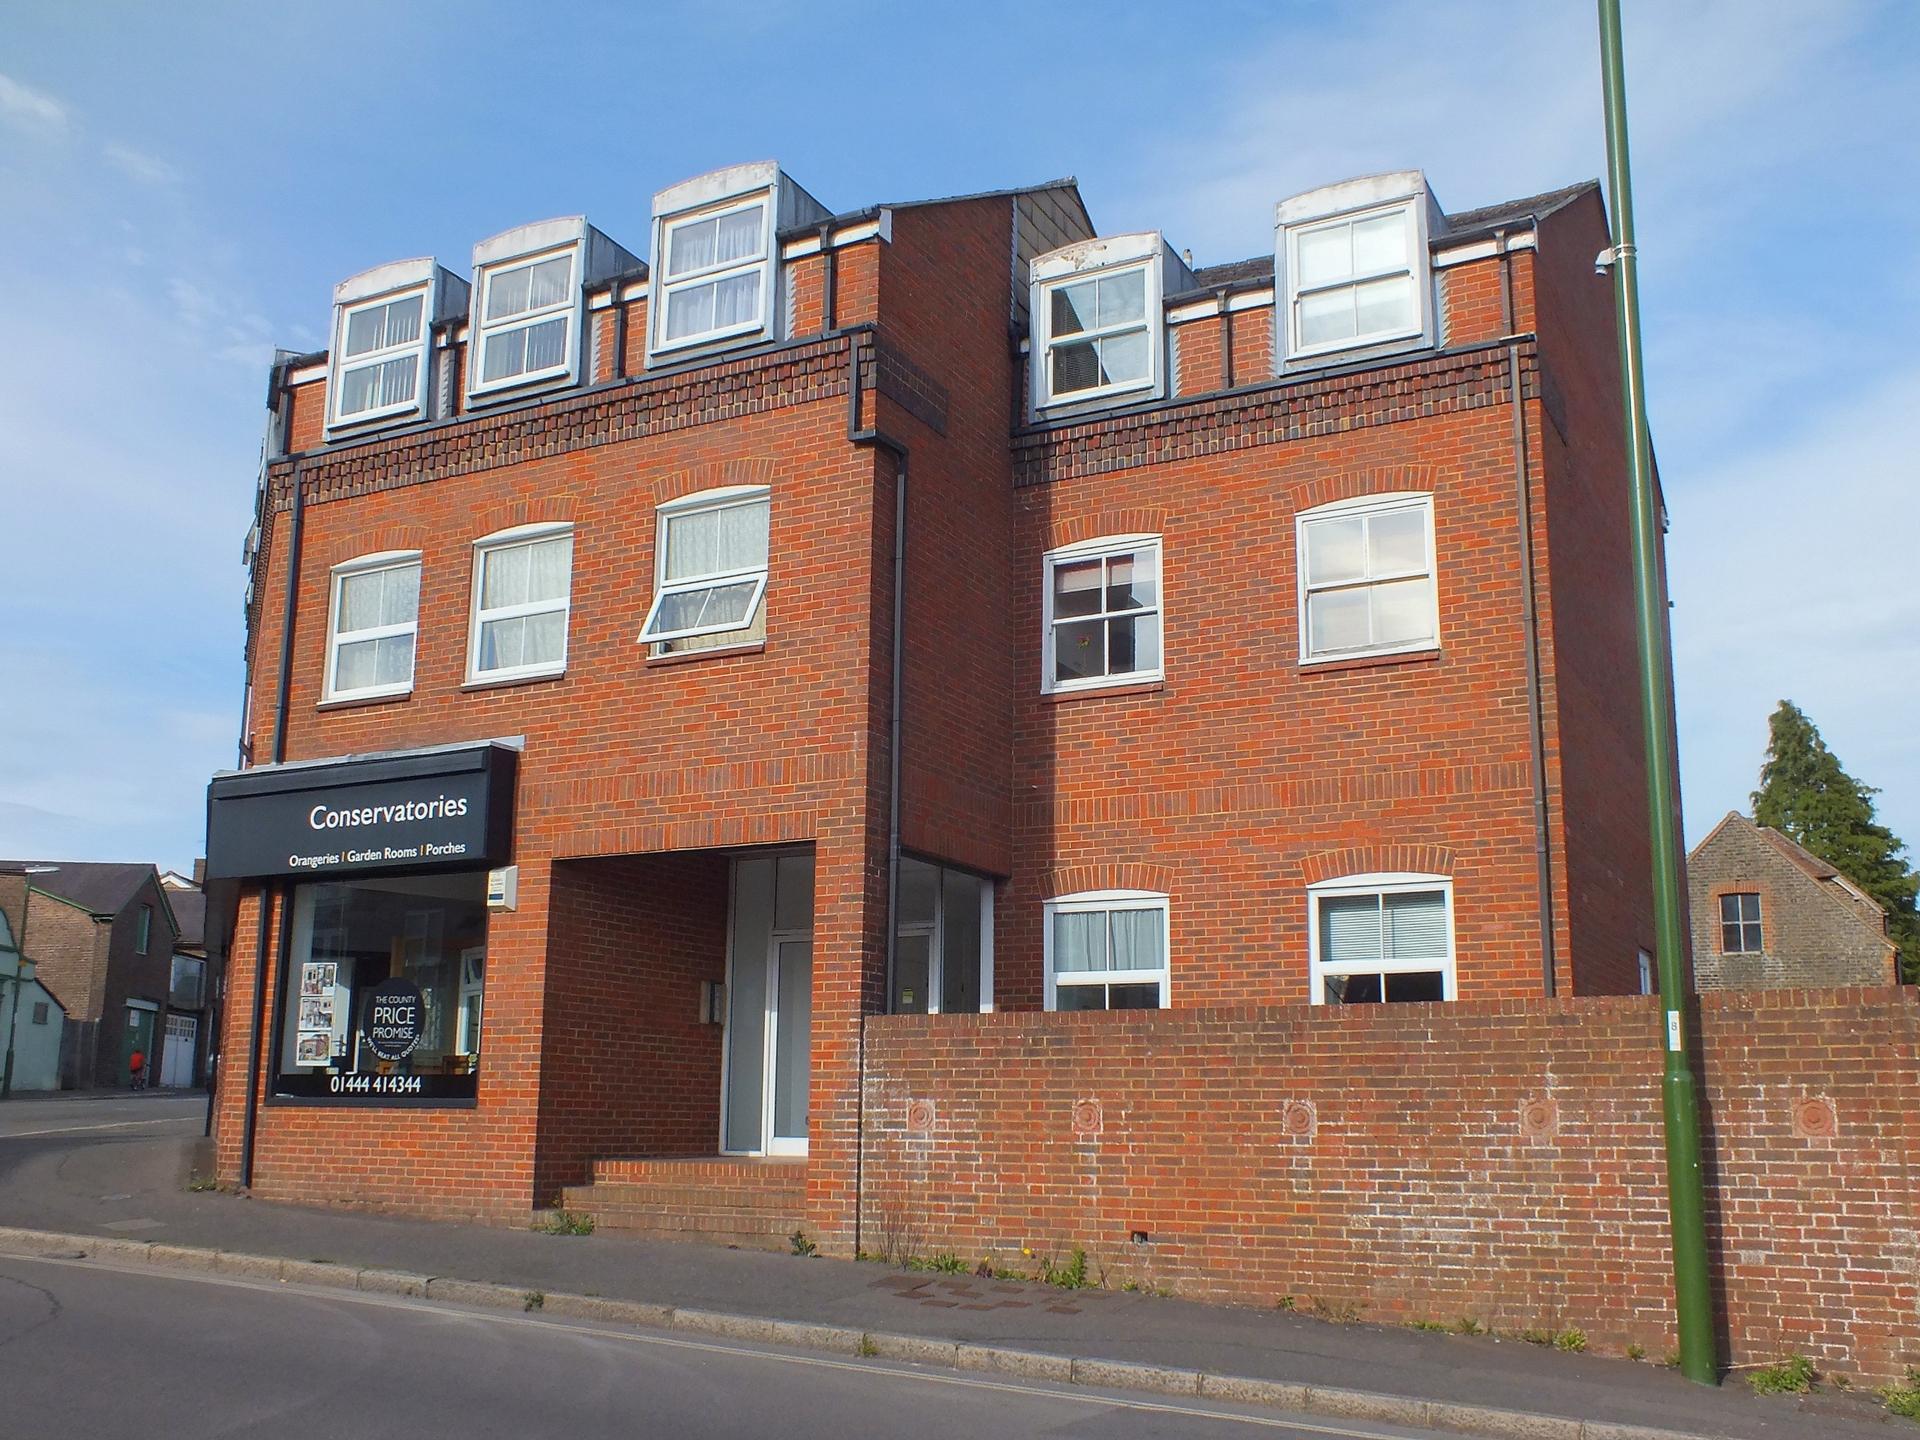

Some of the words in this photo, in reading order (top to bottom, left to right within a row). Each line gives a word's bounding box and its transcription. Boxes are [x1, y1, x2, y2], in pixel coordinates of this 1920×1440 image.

[309, 794, 468, 830] Conservatories
[289, 853, 340, 868] Orangeries
[347, 848, 382, 862] Garden
[384, 847, 418, 859] Rooms
[426, 842, 466, 856] Porches
[376, 996, 388, 1004] THE
[389, 996, 416, 1004] COUNTY
[374, 1007, 416, 1025] PRICE
[373, 1027, 414, 1039] PROMISE
[377, 1050, 391, 1060] BEAT
[330, 1076, 370, 1093] 01444
[372, 1076, 421, 1093] 414344
